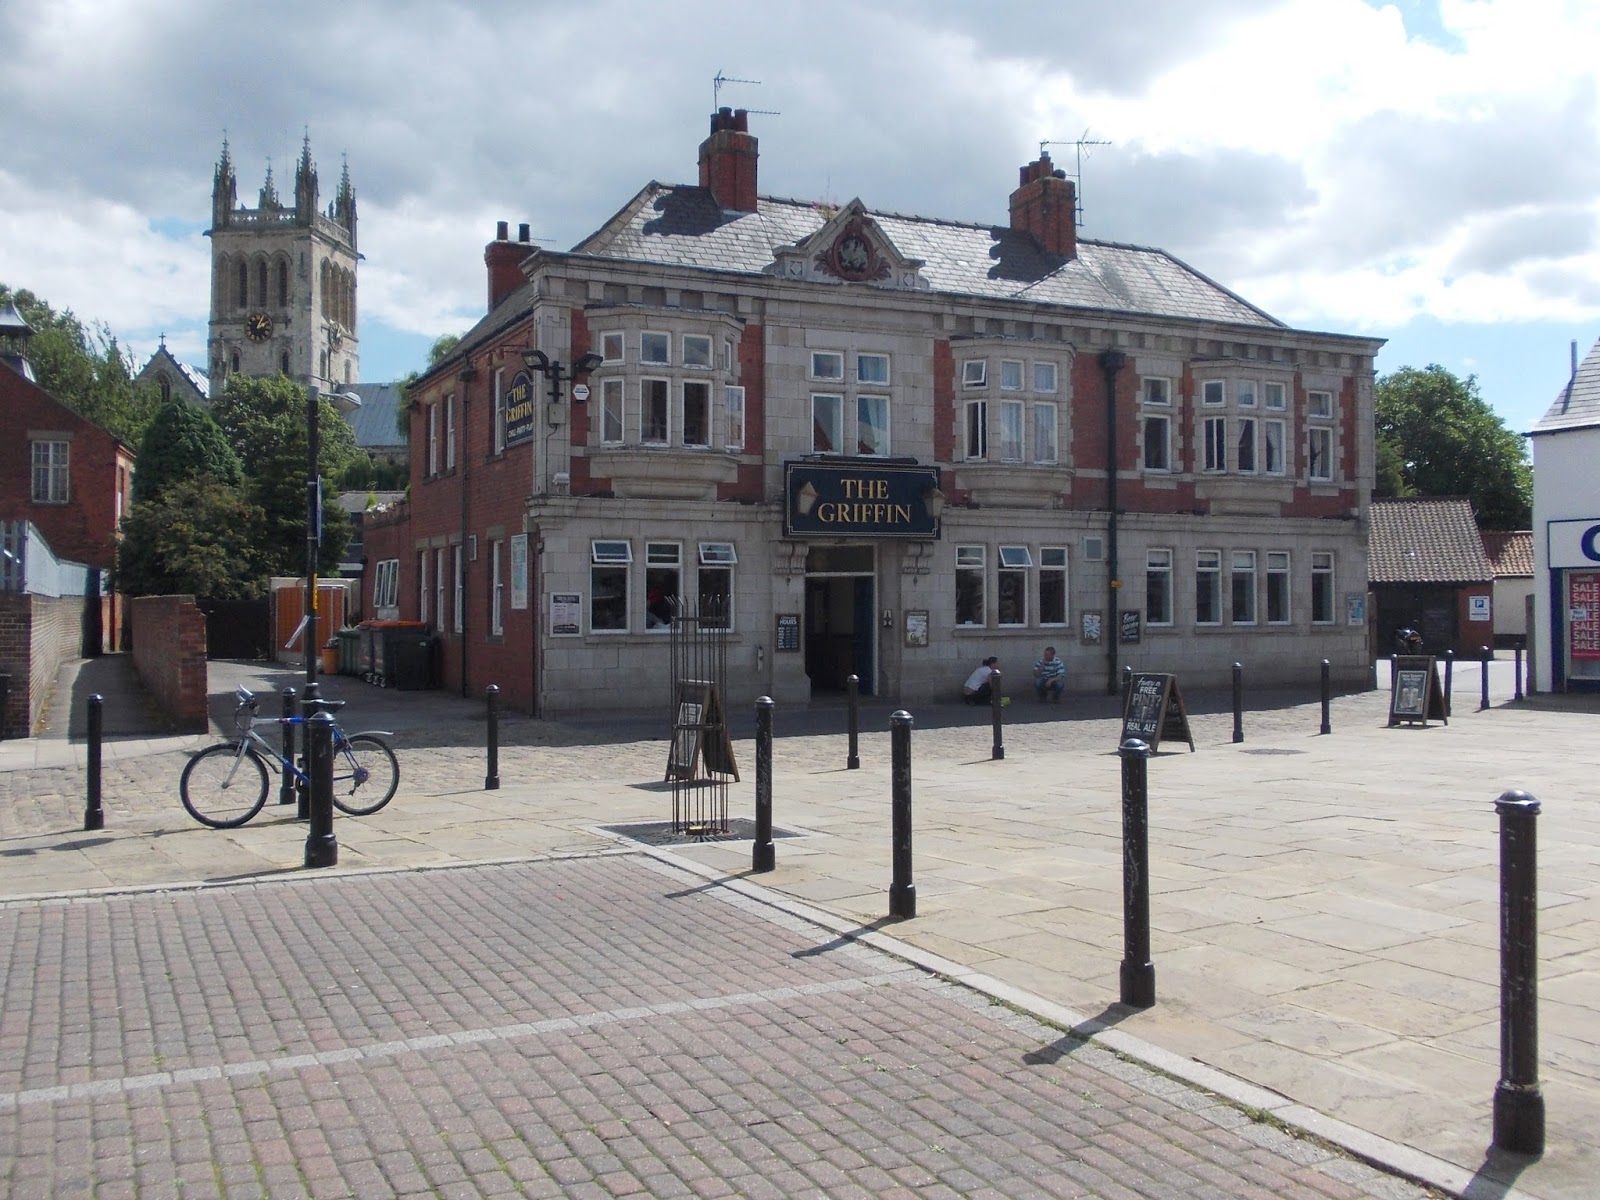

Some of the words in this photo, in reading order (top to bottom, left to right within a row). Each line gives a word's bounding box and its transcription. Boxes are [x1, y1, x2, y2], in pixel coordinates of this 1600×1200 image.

[512, 384, 527, 403] THE
[506, 400, 533, 424] GRIFFIN
[840, 479, 889, 499] THE
[817, 502, 912, 524] GRIFFIN
[1572, 583, 1599, 593] SALE
[1573, 593, 1599, 602] SALE
[1573, 603, 1599, 611] SALE
[1574, 622, 1599, 631] SALE
[1574, 632, 1599, 640] SALE
[1574, 641, 1599, 650] SALE
[1140, 686, 1158, 694] FREE
[1132, 693, 1162, 707] PINT?
[1126, 722, 1141, 731] REAL
[1142, 723, 1157, 732] ALE
